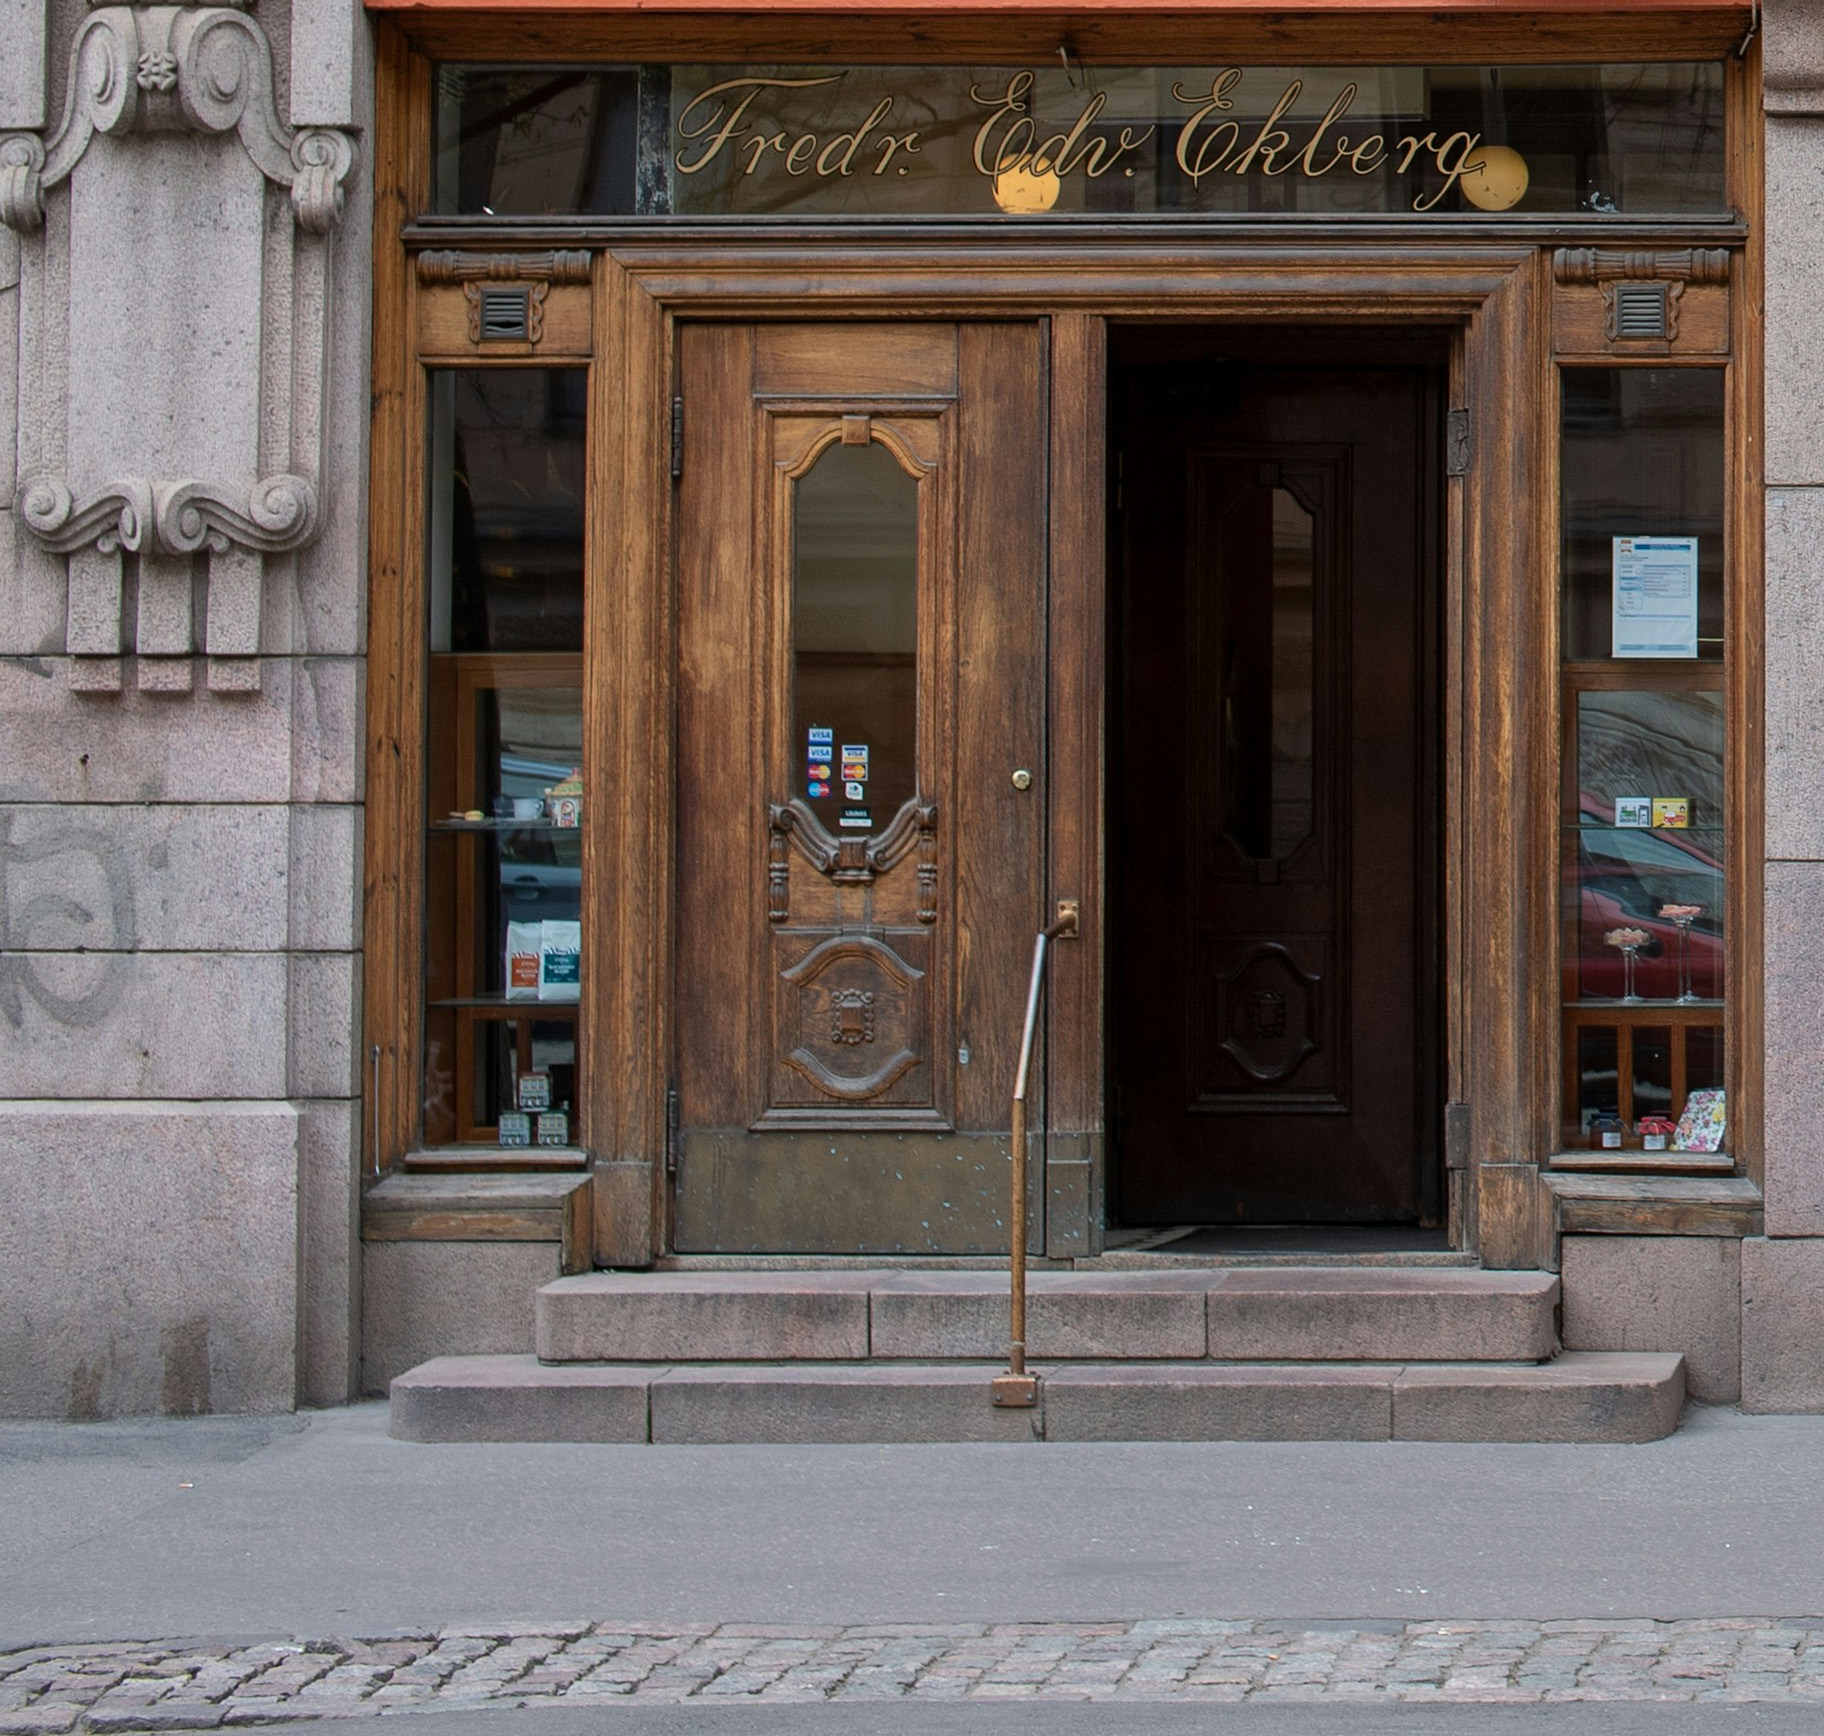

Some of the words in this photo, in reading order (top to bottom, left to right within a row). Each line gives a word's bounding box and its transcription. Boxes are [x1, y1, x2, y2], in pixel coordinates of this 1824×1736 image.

[676, 69, 922, 177] Fredr.
[969, 69, 1155, 200] Edv.
[1172, 67, 1488, 211] Ekberg
[811, 731, 831, 739] VISA
